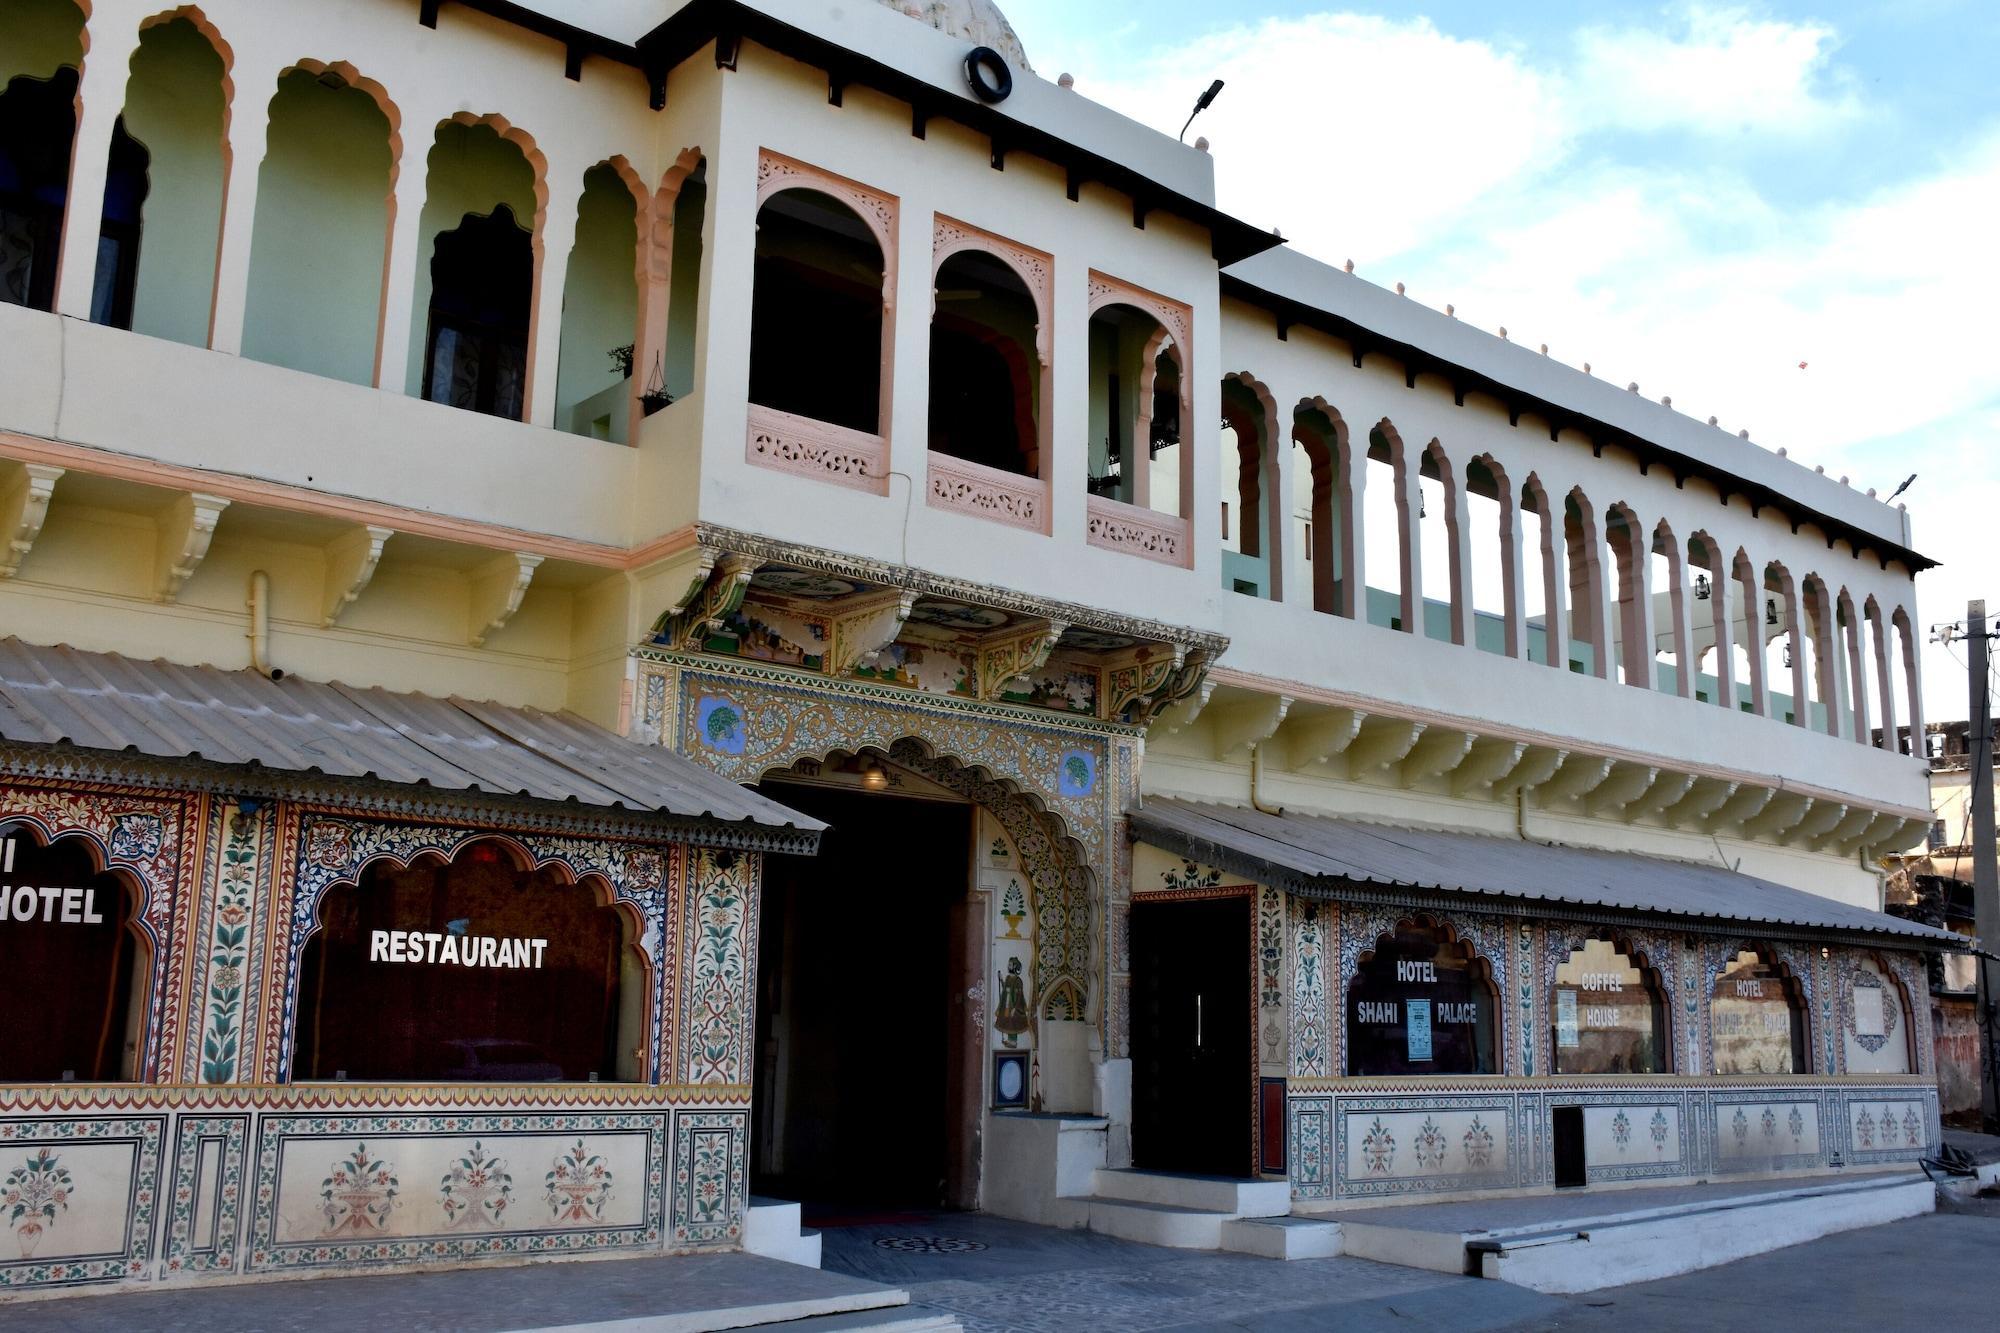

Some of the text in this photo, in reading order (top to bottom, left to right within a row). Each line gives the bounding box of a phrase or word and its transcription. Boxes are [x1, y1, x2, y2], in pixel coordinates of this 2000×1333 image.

[0, 838, 16, 872] I
[370, 930, 547, 969] RESTAURANT
[1397, 960, 1437, 982] HOTEL
[1582, 972, 1622, 992] COFFEE
[1736, 979, 1763, 997] HOTEL
[1358, 1001, 1476, 1024] SHAHI PALACE
[1587, 1009, 1619, 1027] HOUSE
